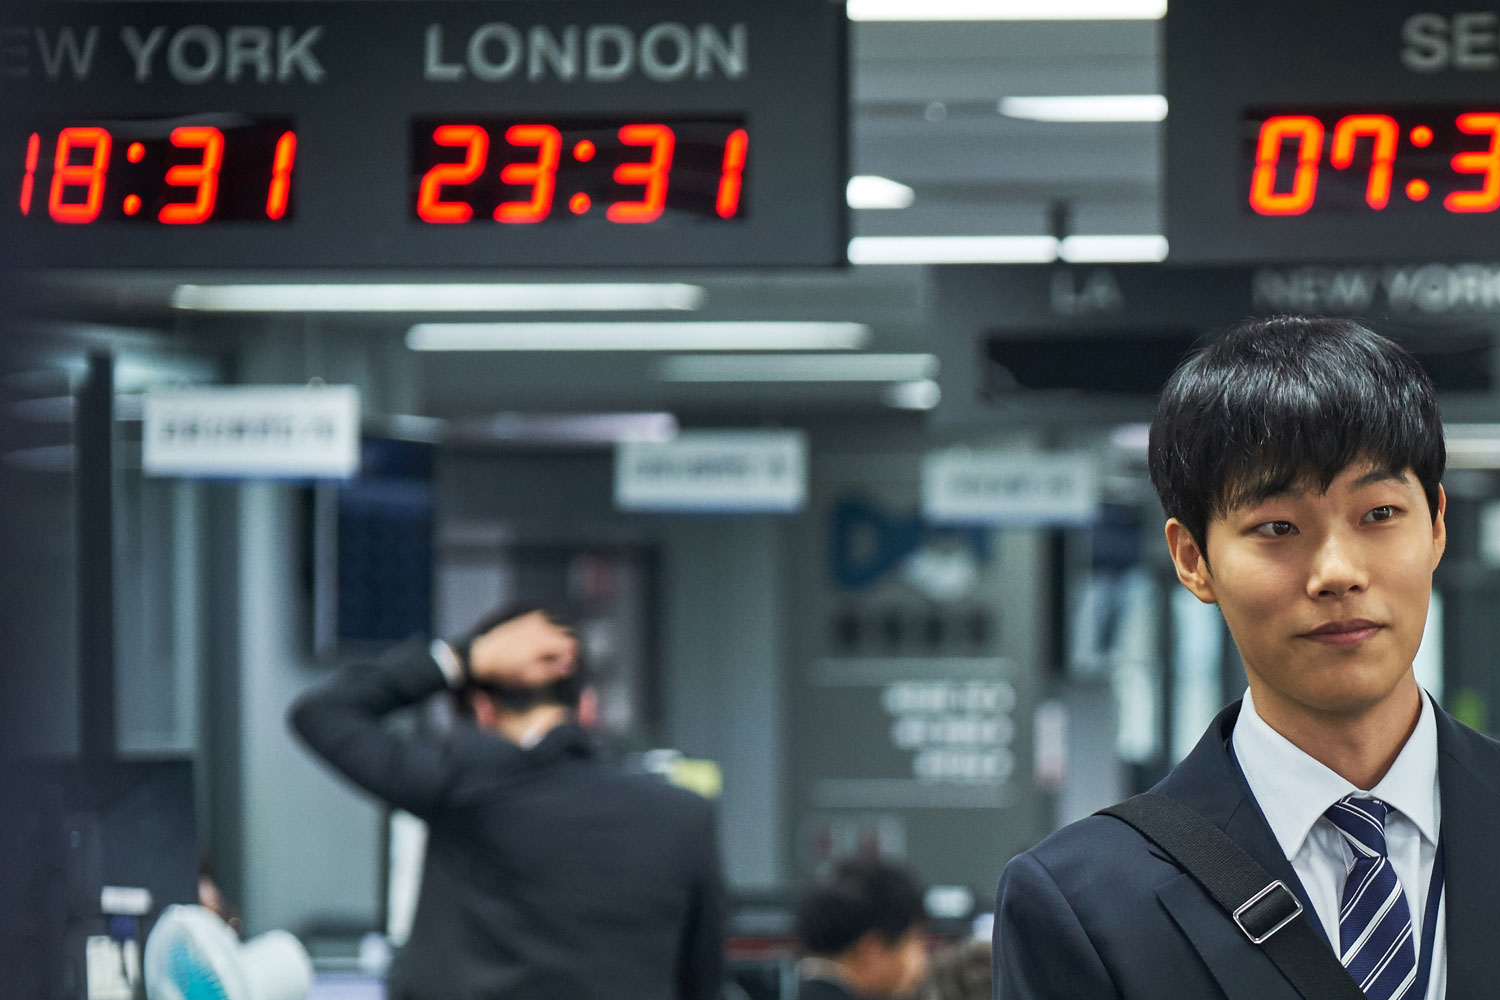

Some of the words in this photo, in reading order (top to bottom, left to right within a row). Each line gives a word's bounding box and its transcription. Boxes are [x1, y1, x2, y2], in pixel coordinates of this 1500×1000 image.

[121, 24, 328, 84] YORK
[423, 22, 750, 83] LONDON
[19, 126, 297, 225] 18:31
[416, 123, 749, 224] 23:31
[1250, 262, 1372, 311] NEW
